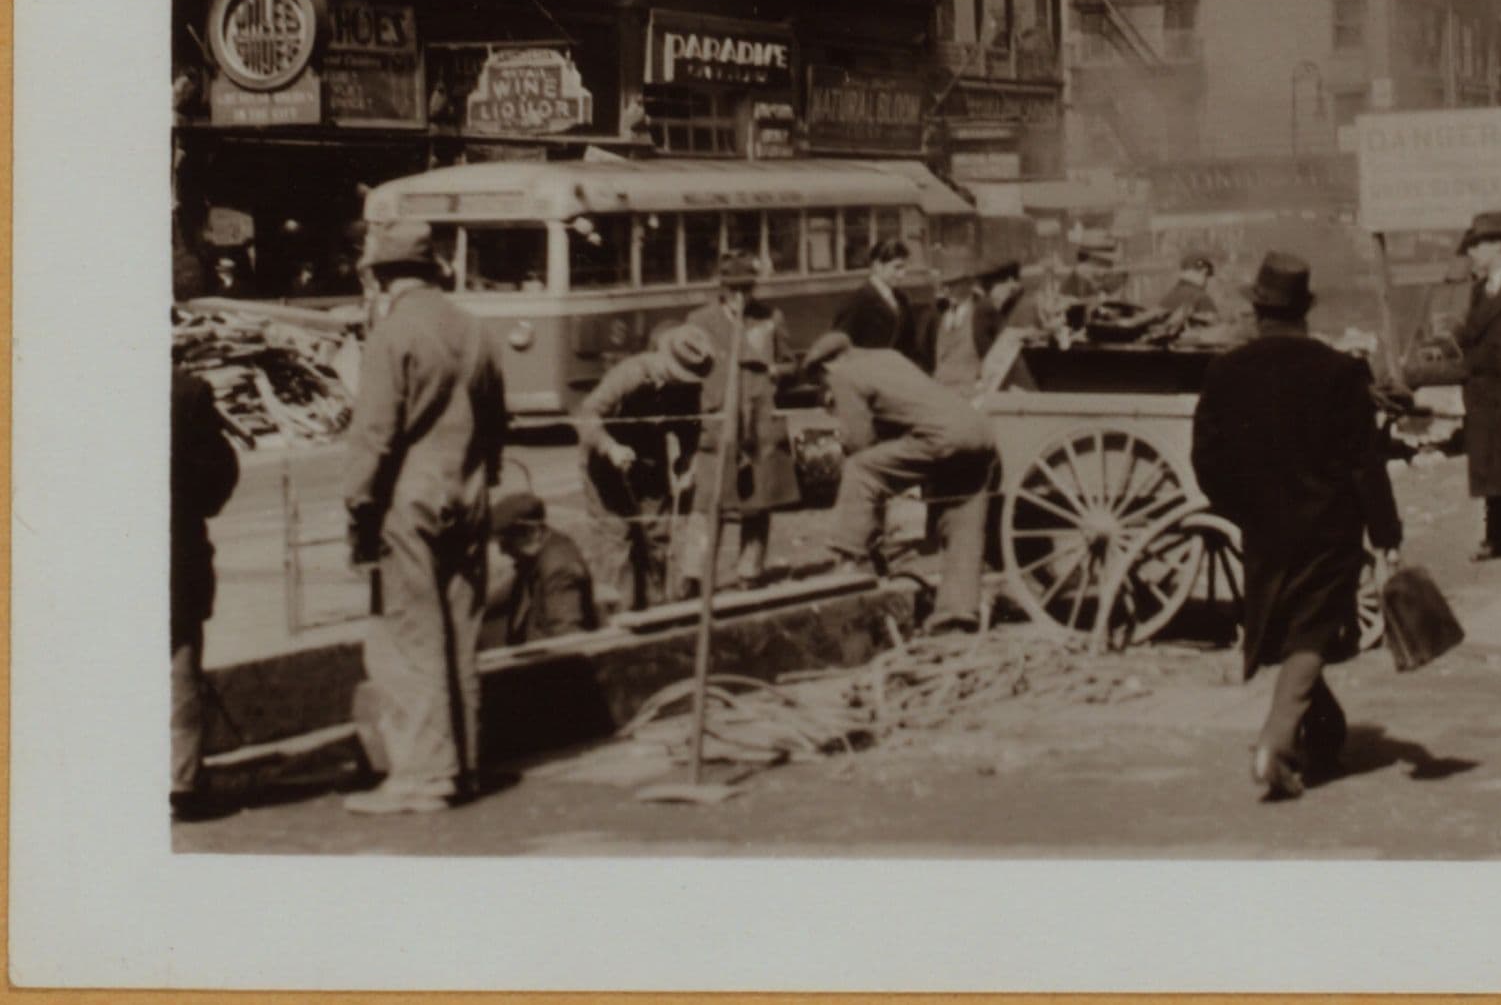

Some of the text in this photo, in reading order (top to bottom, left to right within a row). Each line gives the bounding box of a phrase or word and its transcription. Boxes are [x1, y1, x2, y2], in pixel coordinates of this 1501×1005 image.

[331, 6, 409, 48] HOES
[492, 76, 558, 101] WINE
[480, 99, 570, 122] LIQUOR
[1367, 123, 1498, 151] DANGER
